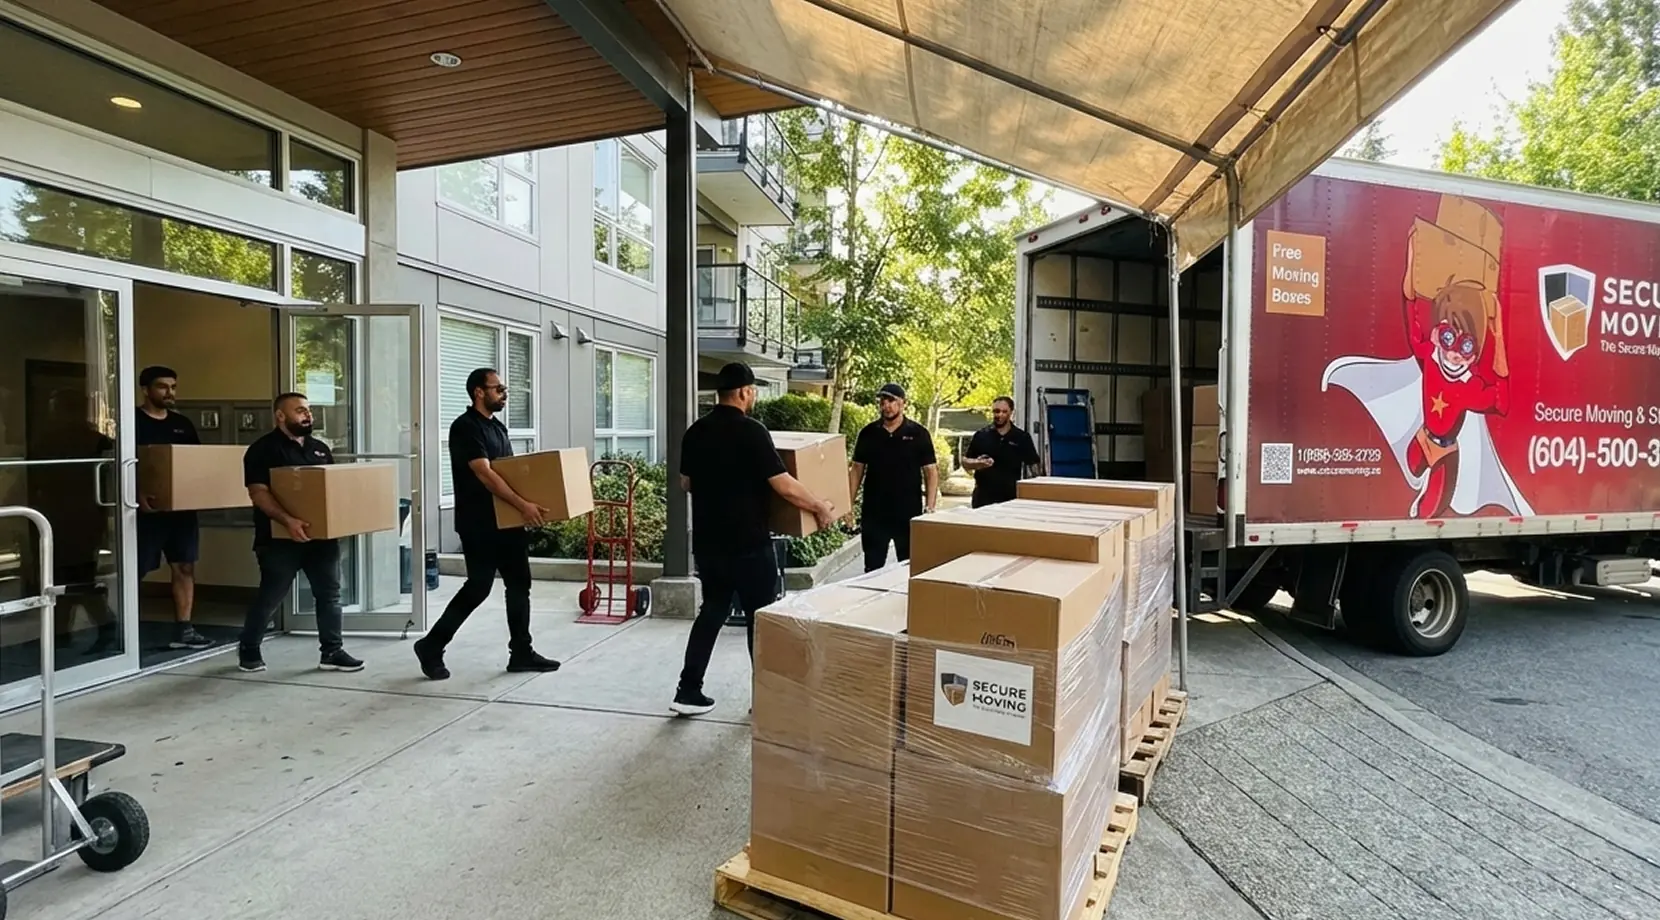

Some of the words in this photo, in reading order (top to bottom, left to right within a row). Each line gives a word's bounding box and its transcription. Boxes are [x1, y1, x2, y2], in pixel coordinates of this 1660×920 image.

[1534, 402, 1583, 422] Secure
[1586, 404, 1633, 429] Moving
[1636, 406, 1645, 424] &
[972, 680, 1027, 700] SECURE
